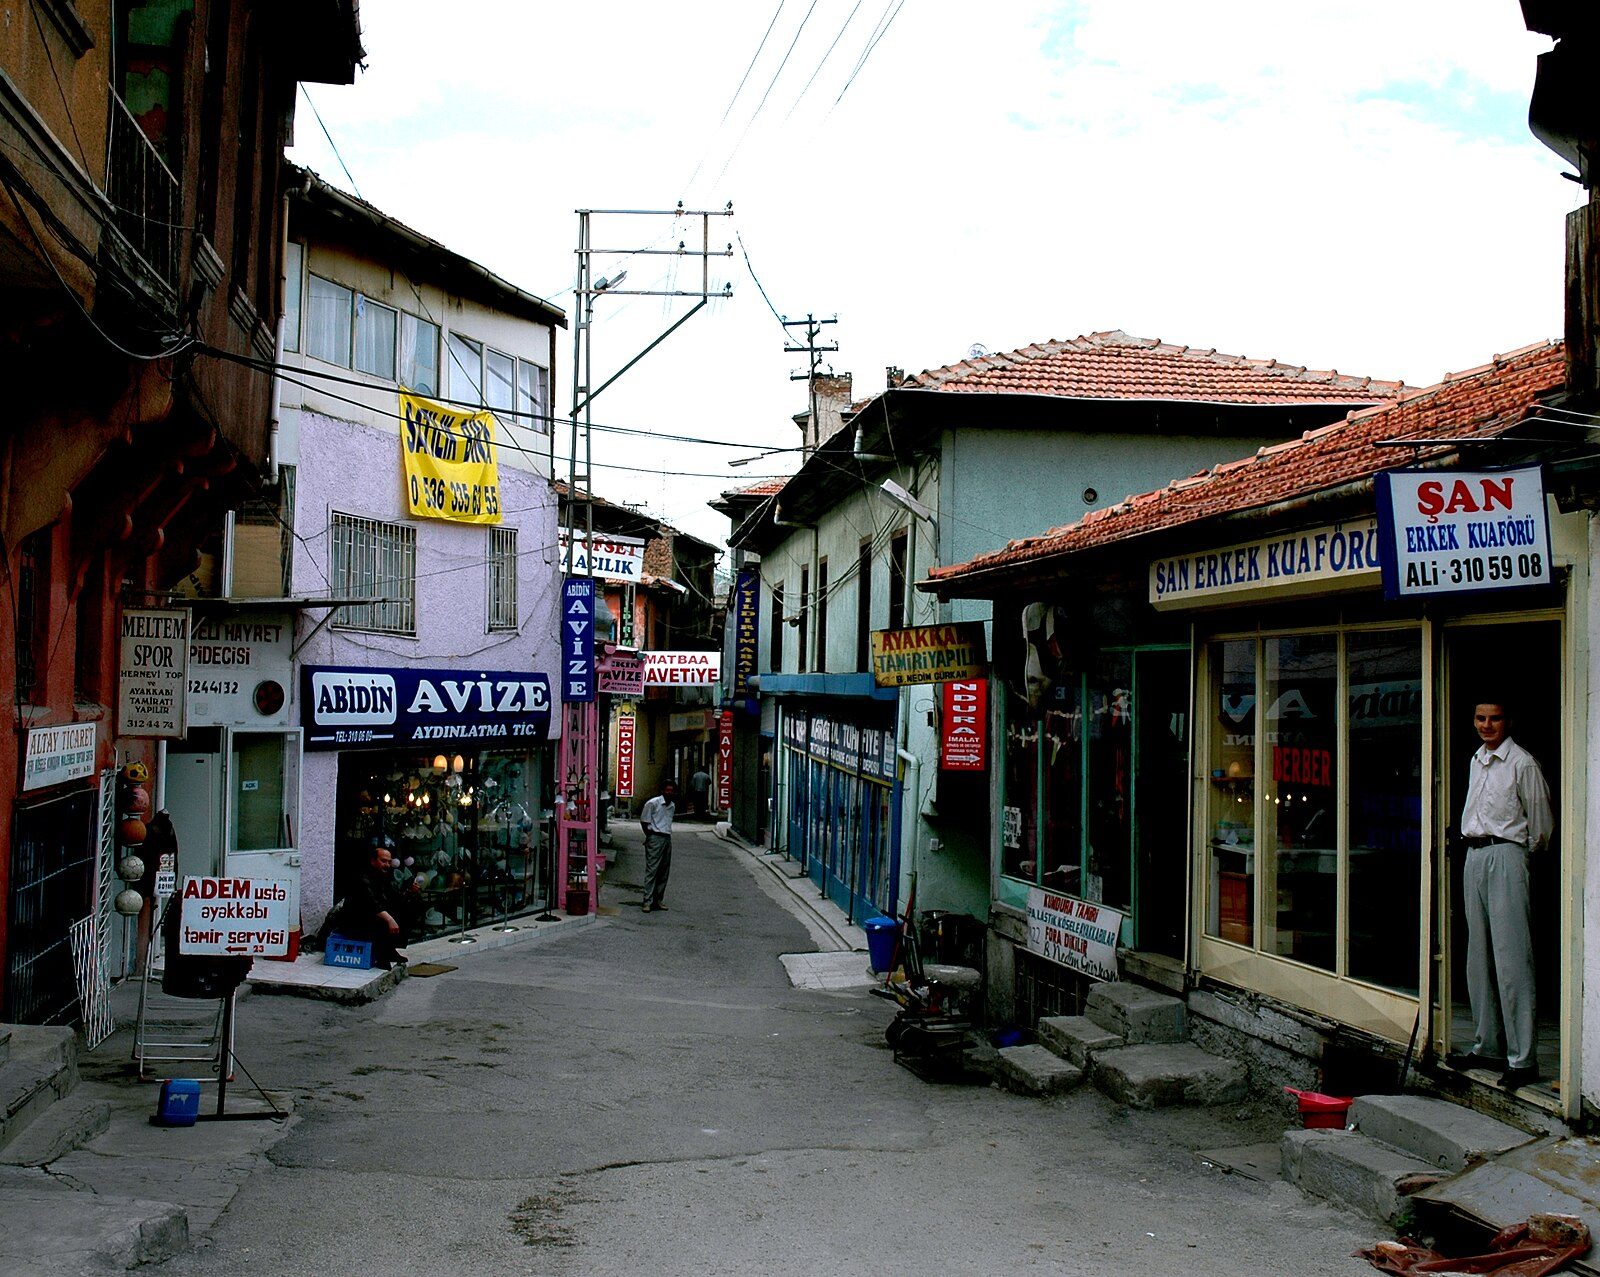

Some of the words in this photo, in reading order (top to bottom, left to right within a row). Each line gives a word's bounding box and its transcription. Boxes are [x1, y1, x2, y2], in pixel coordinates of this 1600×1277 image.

[411, 474, 418, 506] 0
[423, 477, 445, 510] 536
[450, 481, 470, 513] 335
[484, 486, 498, 515] 55
[1417, 478, 1514, 523] ŞAN
[1406, 524, 1459, 553] ERKEK
[1467, 514, 1535, 549] KUAFÖRÜ
[1156, 559, 1189, 599] ŞAN
[1195, 545, 1260, 589] ERKEK
[1267, 520, 1381, 578] KUAFÖRÜ
[1450, 558, 1484, 583] 310
[1488, 556, 1513, 581] 59
[1518, 553, 1542, 578] 08
[566, 582, 590, 597] ABİDİN
[122, 616, 186, 640] MELTEM
[225, 624, 283, 642] HAYRET
[882, 626, 970, 652] AYAKKAB
[133, 645, 173, 668] SPOR
[190, 645, 250, 664] PİDECİSİ
[568, 600, 588, 695] AVİZE
[646, 655, 709, 665] MATBAA
[602, 669, 641, 681] AVİZE
[644, 668, 718, 683] AVETİYE
[129, 688, 173, 696] AYAKKABI
[130, 696, 173, 705] TAMİRATI
[317, 679, 393, 714] ABİDİN
[406, 673, 549, 713] AVİZE
[135, 706, 169, 714] YAPILIR
[127, 720, 144, 728] 312
[412, 724, 507, 739] AYDINLATMA
[513, 721, 536, 735] TİC.
[30, 732, 59, 755] ALTAY
[63, 726, 93, 750] TİCARET
[620, 732, 632, 795] DAVETİYE
[721, 736, 730, 797] AVİZE
[1273, 746, 1331, 786] BERBER
[184, 879, 250, 899] ADEM
[254, 883, 286, 901] usta
[1043, 893, 1074, 917] KUNDURA
[185, 926, 223, 944] tamir
[228, 928, 285, 945] servisi
[1045, 926, 1061, 945] FORA
[253, 945, 264, 953] 23
[334, 955, 361, 965] ALTIN
